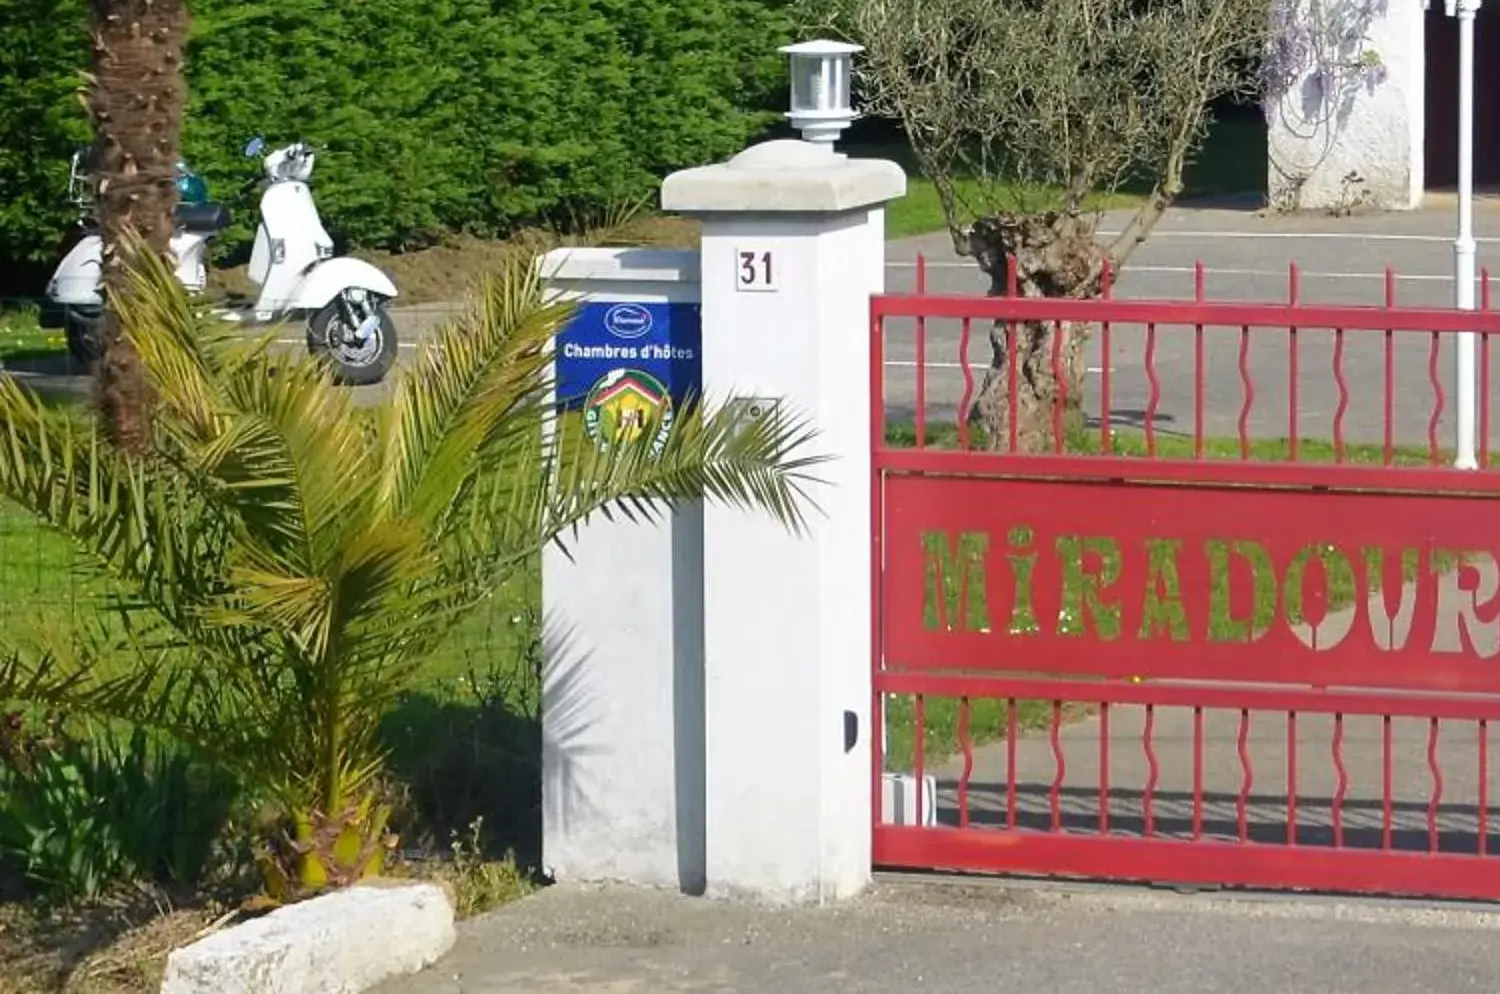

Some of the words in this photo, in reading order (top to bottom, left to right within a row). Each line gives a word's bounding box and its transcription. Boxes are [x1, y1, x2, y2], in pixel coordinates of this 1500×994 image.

[739, 251, 773, 285] 31
[564, 343, 637, 359] Chambres
[641, 344, 693, 359] d'hôtes
